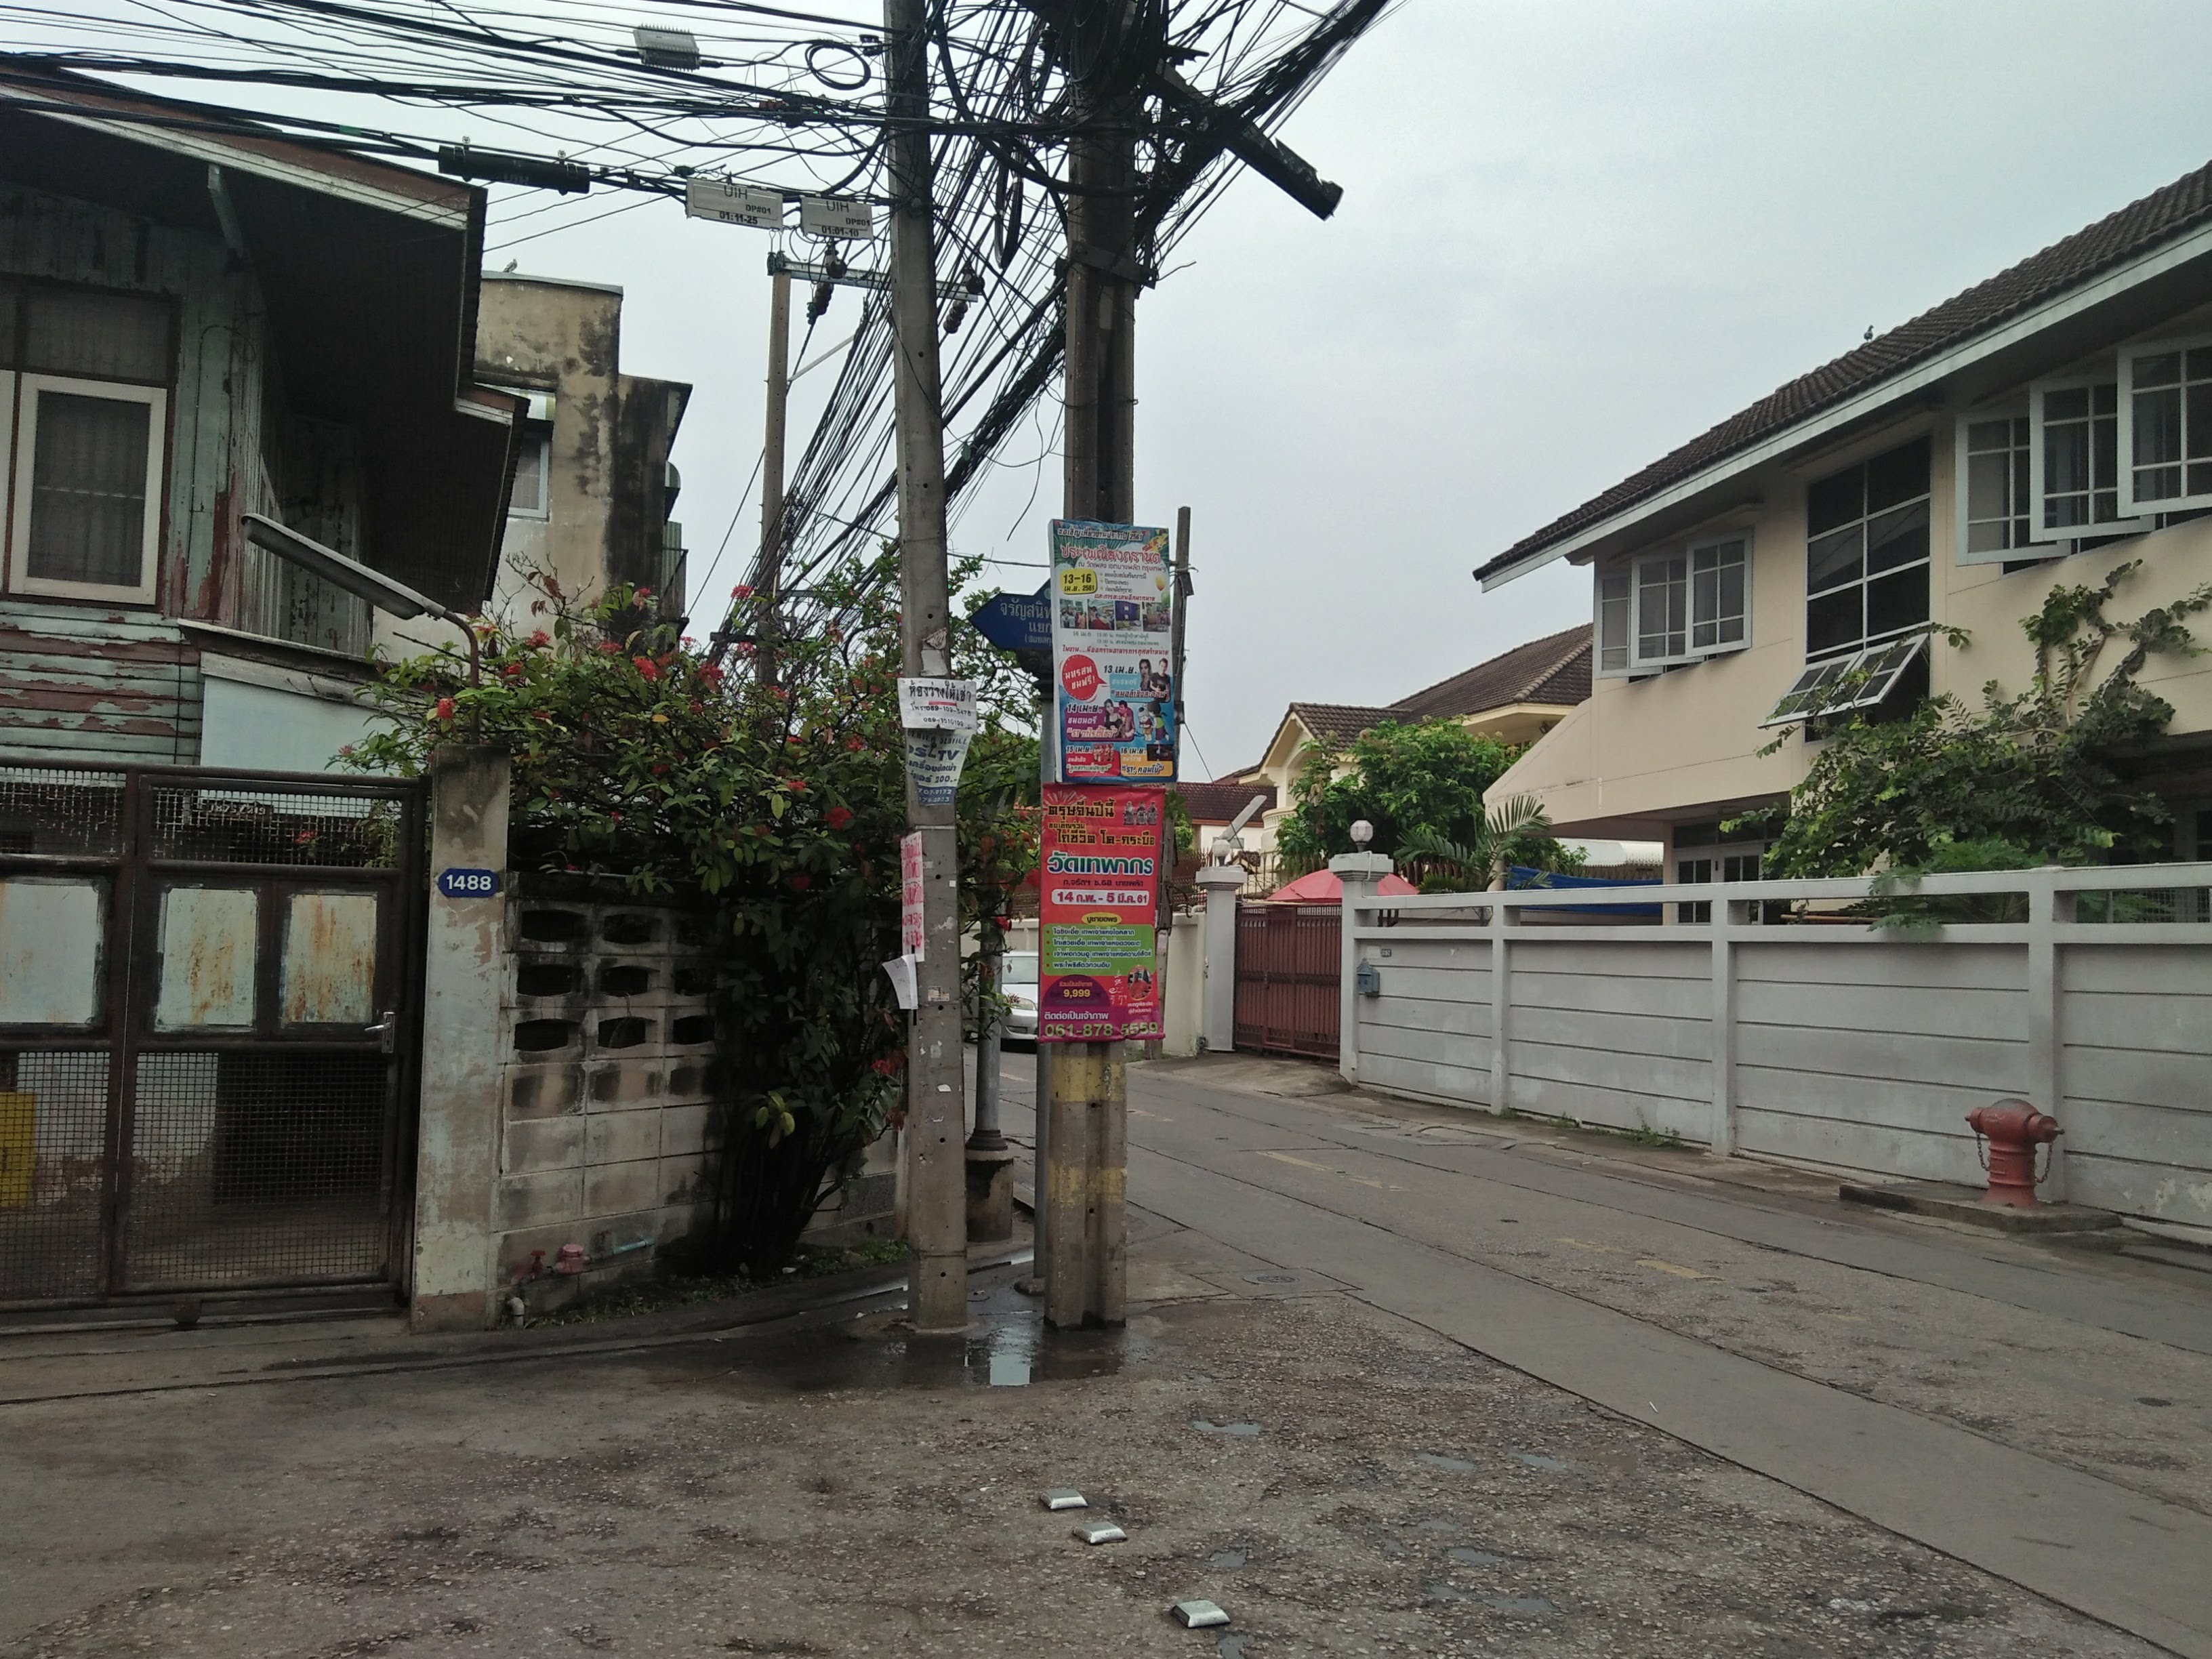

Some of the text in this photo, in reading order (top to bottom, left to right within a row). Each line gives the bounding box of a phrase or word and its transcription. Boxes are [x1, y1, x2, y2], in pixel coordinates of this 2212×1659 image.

[724, 185, 747, 199] UIH
[745, 205, 771, 215] DP#01
[826, 201, 850, 213] UIH
[719, 211, 758, 224] 01:11-25
[845, 218, 870, 226] DP#01
[821, 226, 859, 237] 01:01-10
[1063, 573, 1092, 584] 13-16
[1104, 665, 1112, 674] 13
[1067, 704, 1076, 712] 14
[1048, 851, 1153, 875] วัดเทพากร
[446, 874, 491, 890] 1488
[1057, 892, 1073, 903] 14
[1076, 894, 1097, 903] ก.พ.
[1107, 893, 1115, 903] 5
[1137, 895, 1147, 903] 61
[1063, 989, 1090, 998] 9,999
[1044, 1010, 1109, 1020] ติดต่อเป็นเจ้าภาพ
